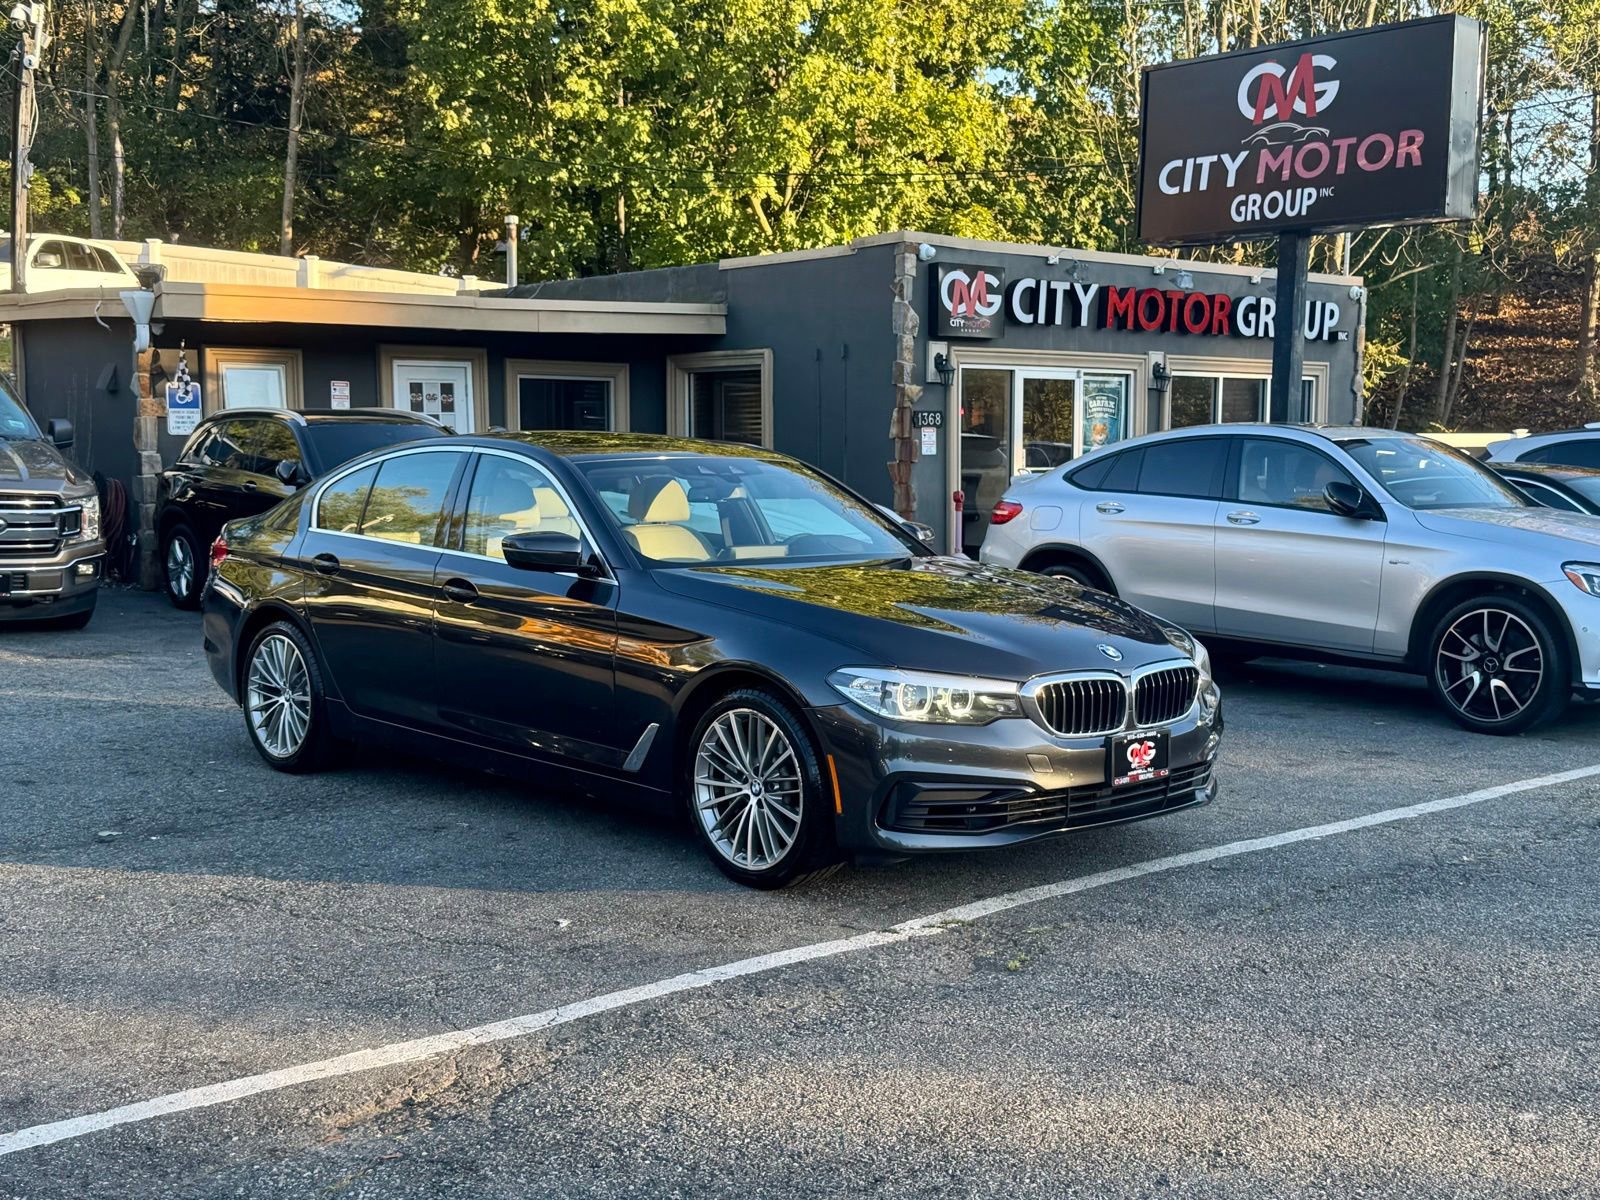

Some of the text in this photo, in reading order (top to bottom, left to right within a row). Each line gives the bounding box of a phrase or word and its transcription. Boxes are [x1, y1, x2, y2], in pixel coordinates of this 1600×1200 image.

[1158, 128, 1425, 195] CITY MOTOR
[1231, 186, 1335, 223] GROUP INC
[1011, 278, 1099, 328] CITY
[1106, 285, 1231, 335] MOTOR
[1236, 295, 1340, 341] GRUP
[918, 412, 941, 426] 1368
